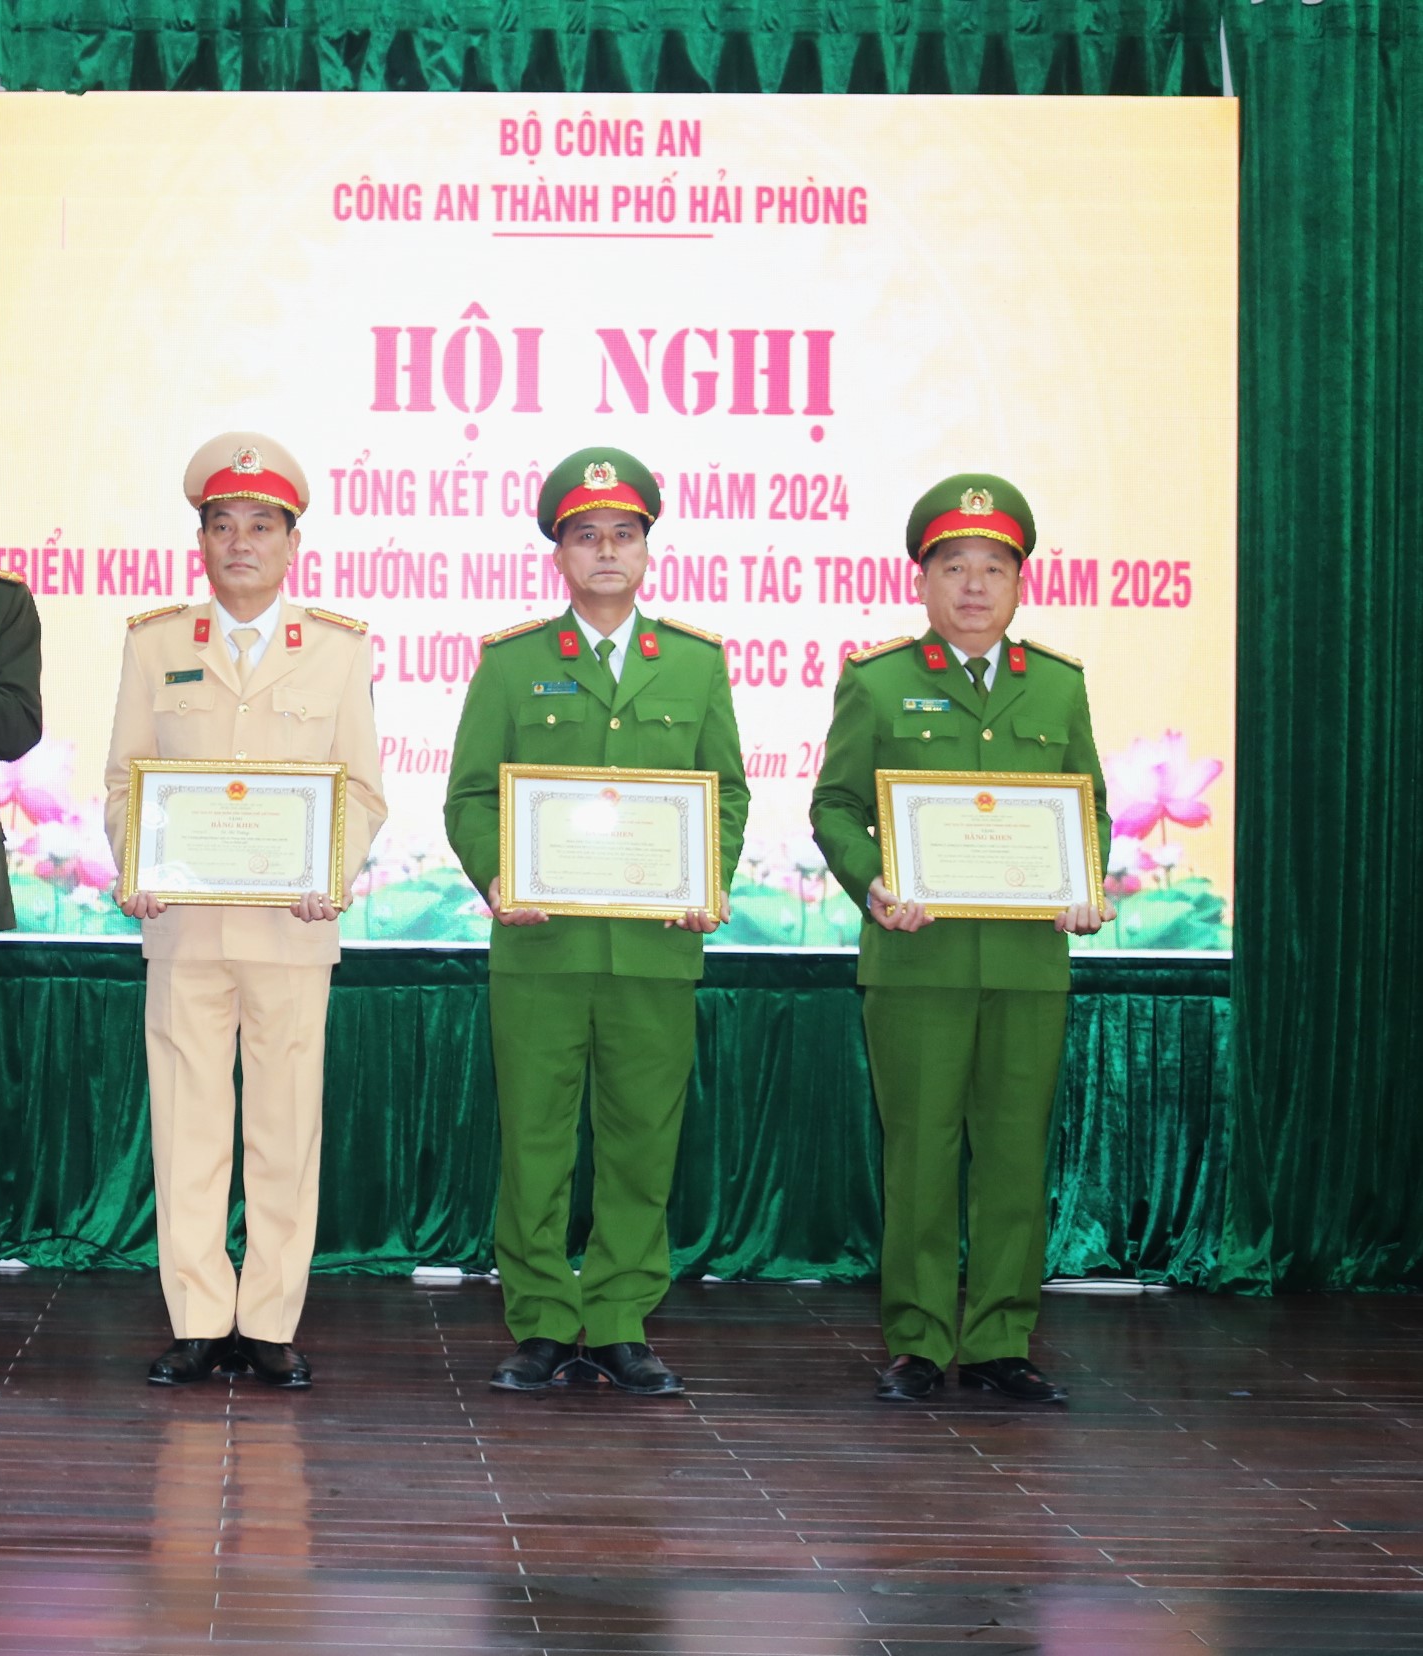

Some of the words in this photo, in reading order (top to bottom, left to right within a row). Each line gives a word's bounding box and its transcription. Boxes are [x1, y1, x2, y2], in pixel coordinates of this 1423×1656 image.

[500, 110, 542, 165] BỘ
[555, 110, 644, 157] CÔNG
[656, 119, 701, 157] AN
[333, 175, 423, 221] CÔNG
[434, 183, 479, 222] AN
[491, 176, 599, 222] THÀNH
[612, 171, 678, 223] PHỐ
[689, 168, 743, 223] HẢI
[755, 176, 867, 225] PHÒNG
[370, 302, 543, 440] HỘI
[595, 327, 835, 443] NGHỊ
[330, 449, 416, 516] TỔNG
[429, 453, 488, 517] KẾT
[679, 462, 756, 519] NĂM
[769, 473, 849, 521] 2024
[97, 548, 173, 596] KHAI
[335, 537, 448, 599] HƯỚNG
[461, 543, 571, 611] NHIỆM
[637, 544, 728, 602] CÔNG
[740, 545, 803, 604] TÁC
[1021, 548, 1098, 607] NĂM
[1111, 560, 1192, 608] 2025
[801, 640, 825, 688] &
